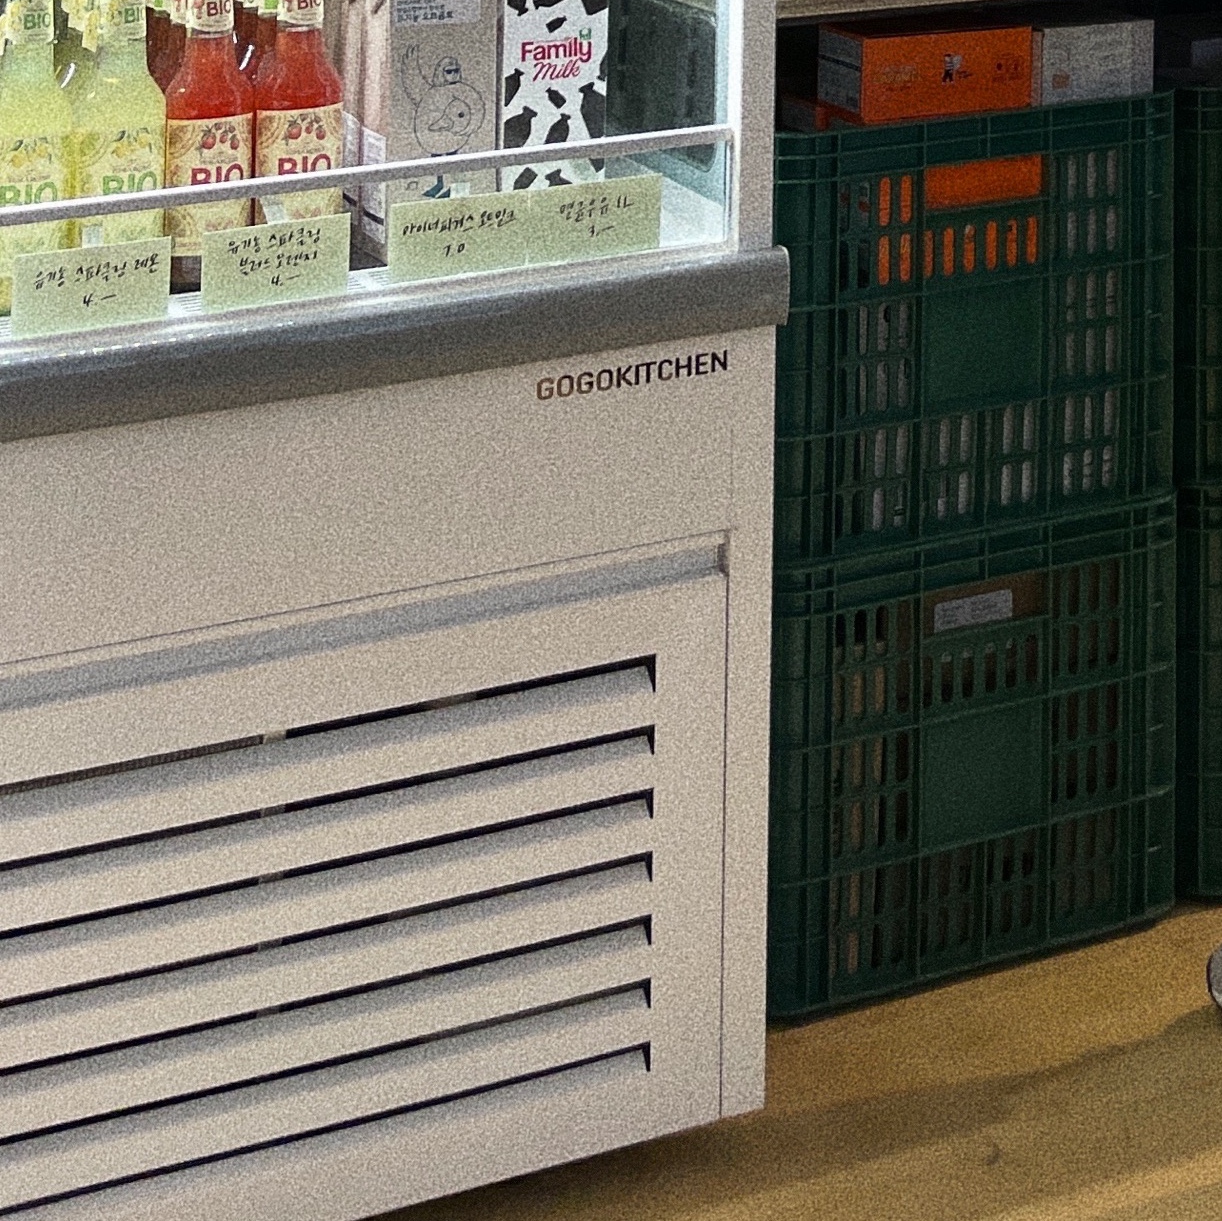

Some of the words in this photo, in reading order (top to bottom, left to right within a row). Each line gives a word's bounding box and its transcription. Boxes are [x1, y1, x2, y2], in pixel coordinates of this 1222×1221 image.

[23, 12, 51, 30] BIO
[521, 36, 592, 63] Family
[532, 58, 582, 82] Milk
[559, 198, 609, 223] 멸균우유
[228, 235, 262, 255] 유기농
[266, 226, 321, 250] 스파클링
[34, 266, 66, 290] 유기농
[74, 261, 128, 283] 스파클링
[134, 252, 161, 274] 레몬
[239, 256, 272, 276] 블러드
[276, 249, 319, 270] 오렌지
[536, 349, 729, 401] GOGOKITCHEN
